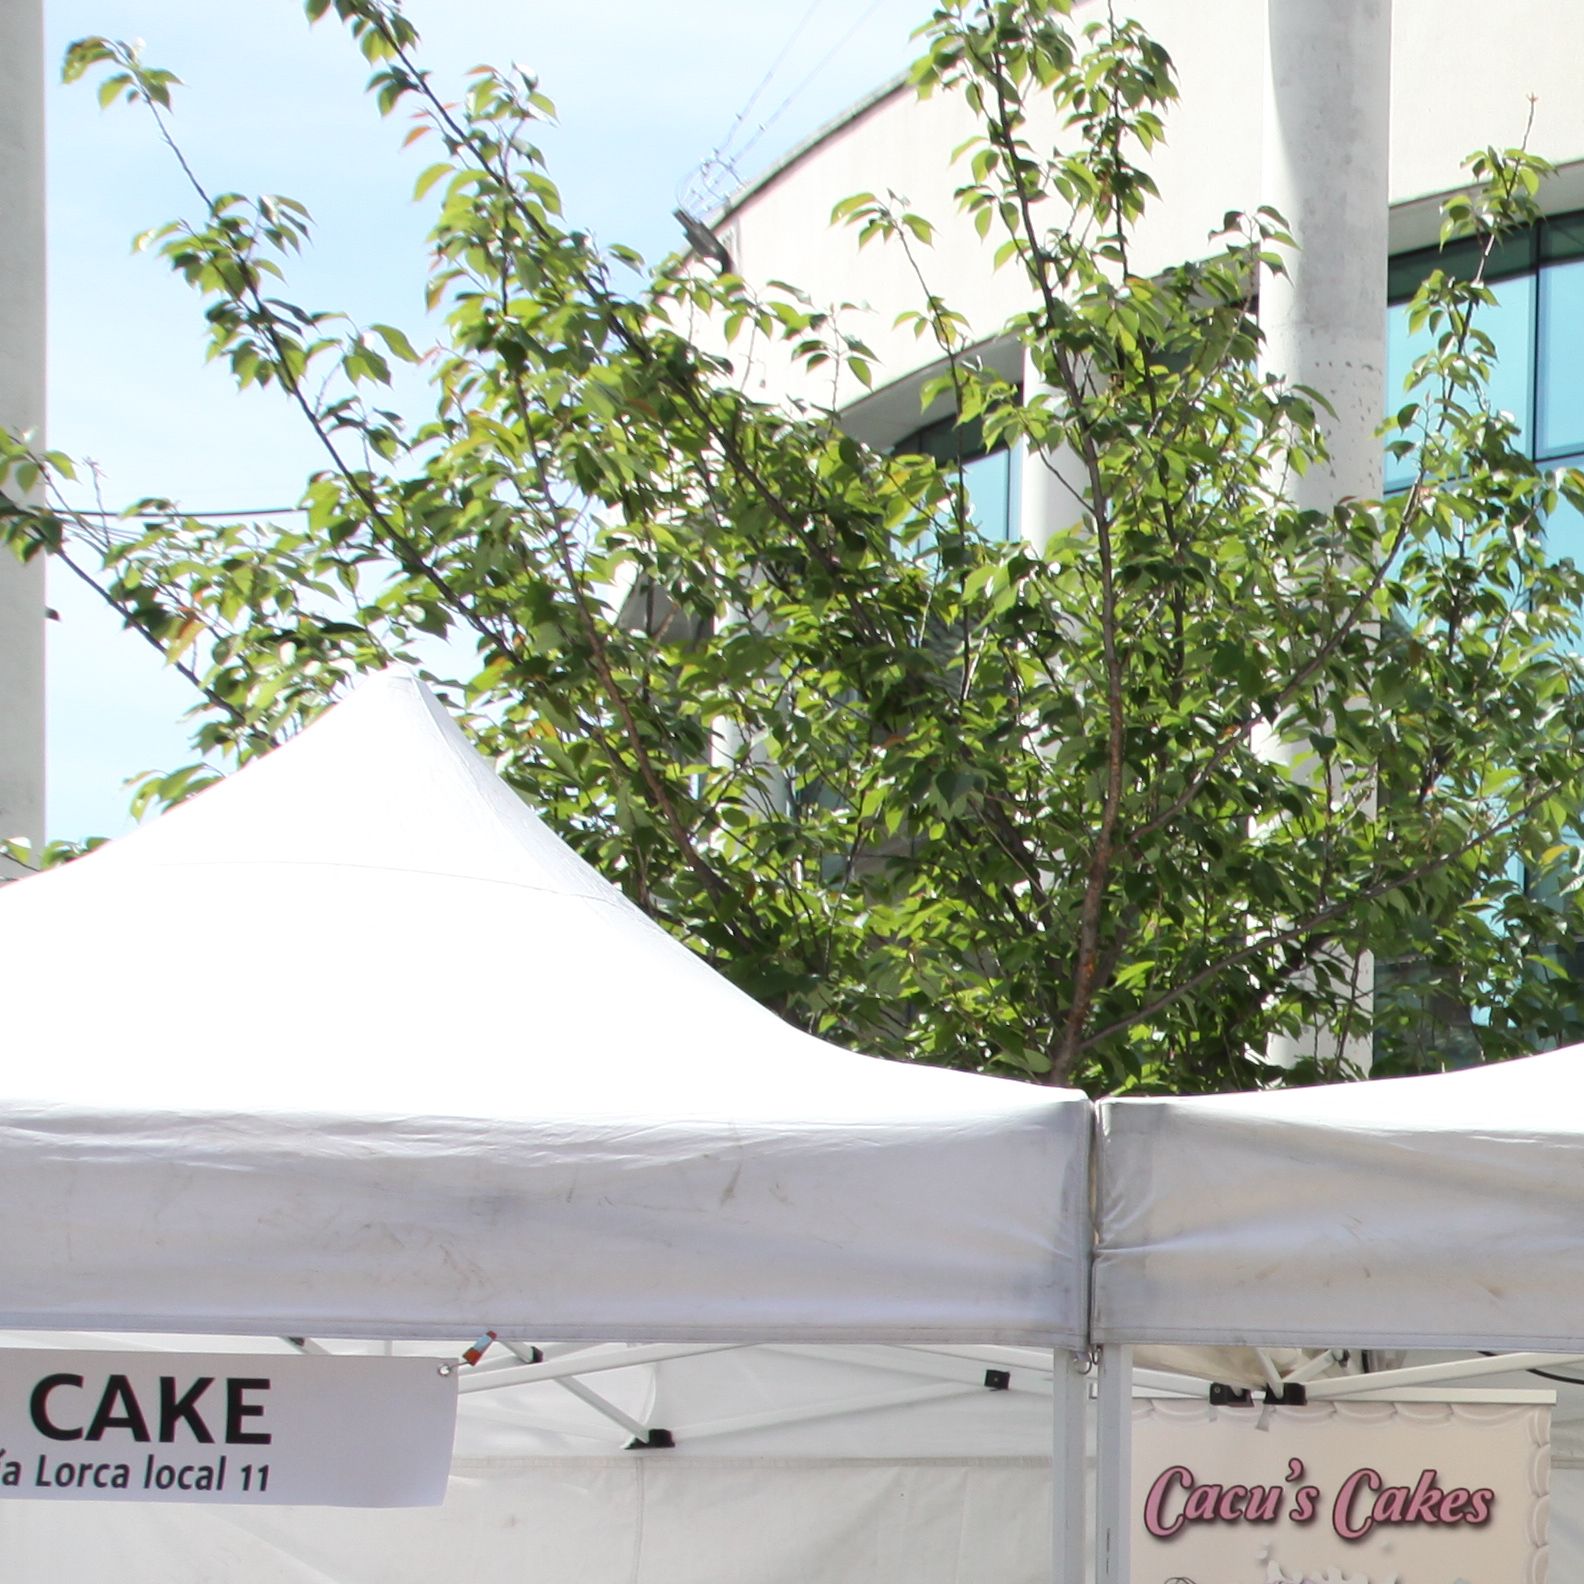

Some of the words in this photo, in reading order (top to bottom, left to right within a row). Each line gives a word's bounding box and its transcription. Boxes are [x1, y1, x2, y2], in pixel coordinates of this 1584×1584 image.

[29, 1372, 273, 1446] CAKE
[35, 1454, 131, 1489] Lorca
[144, 1454, 227, 1491] local
[240, 1464, 270, 1492] 11
[1143, 1457, 1320, 1537] Cacu's
[1332, 1467, 1495, 1540] Cakes
